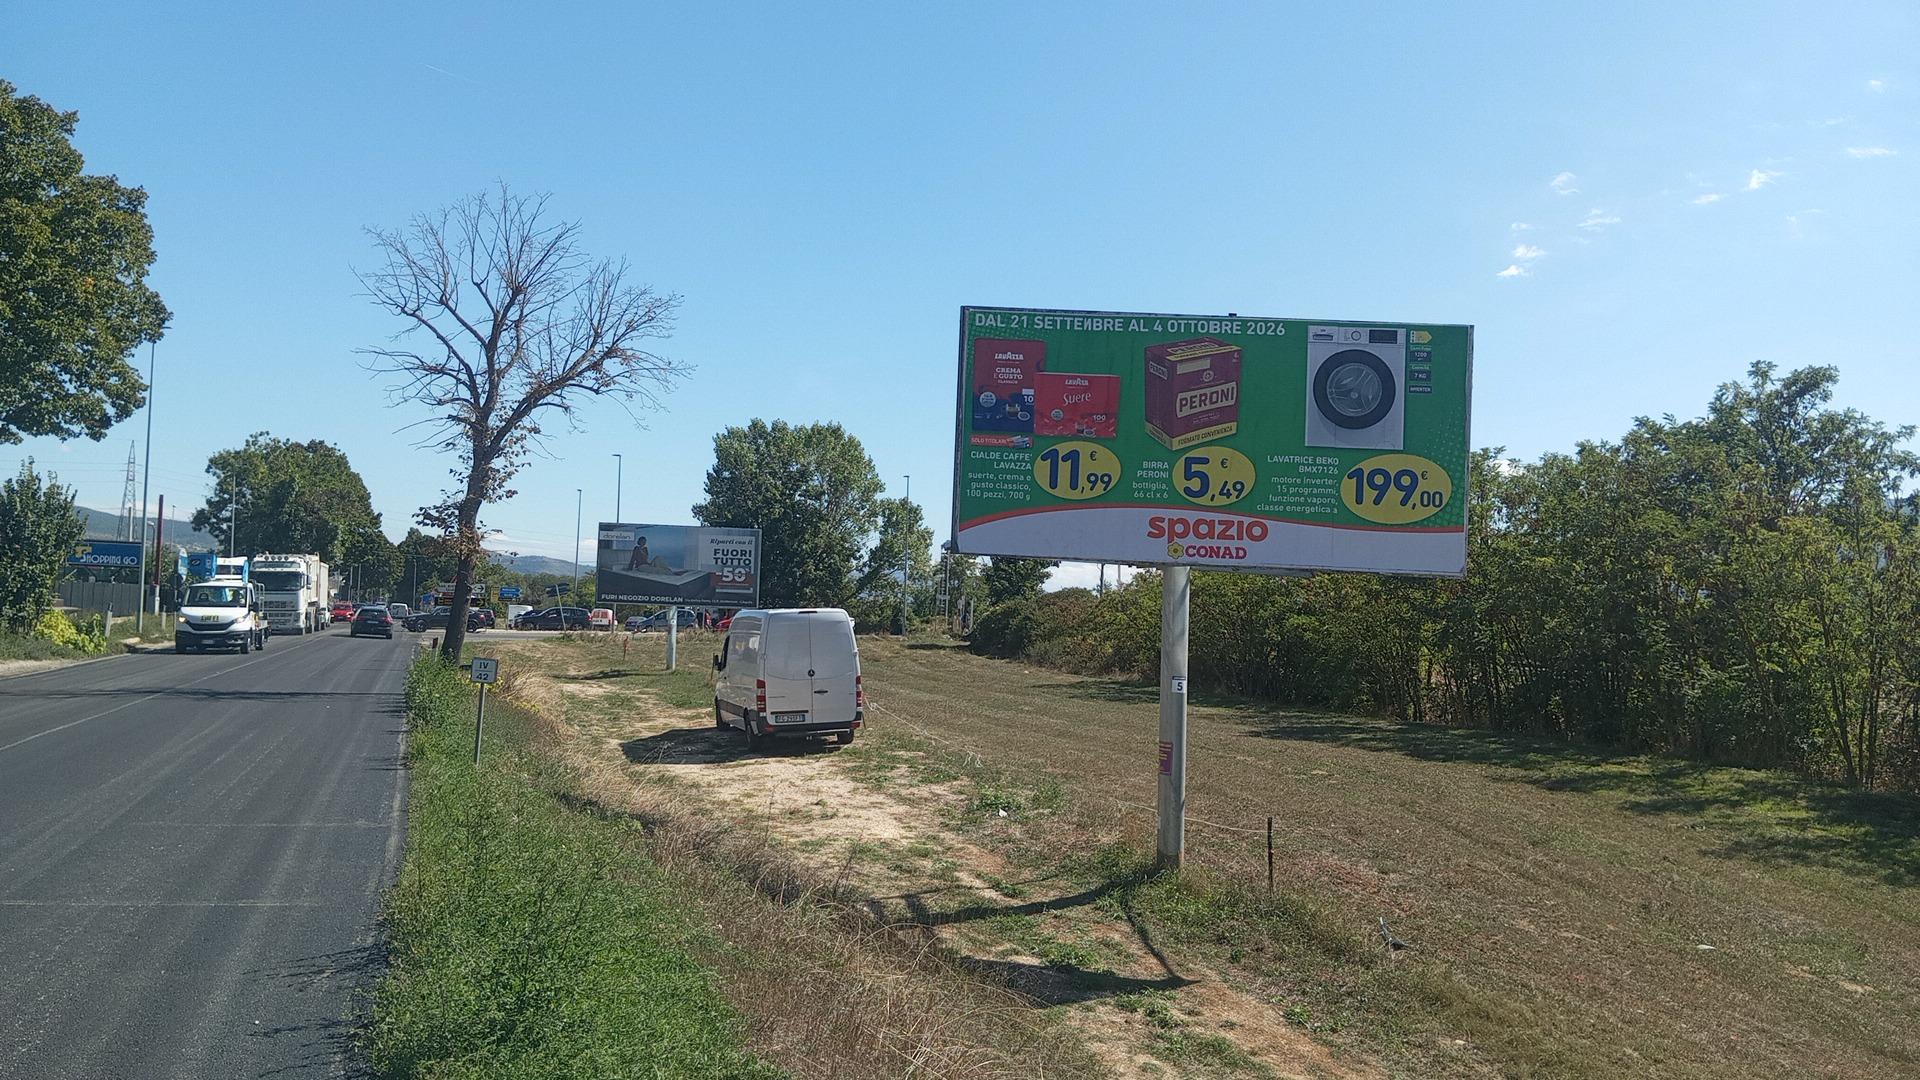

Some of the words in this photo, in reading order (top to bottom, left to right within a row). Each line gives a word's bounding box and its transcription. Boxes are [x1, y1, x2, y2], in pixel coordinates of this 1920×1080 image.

[975, 314, 1006, 328] DAL
[1010, 315, 1028, 328] 21
[1128, 320, 1149, 332] AL
[1153, 320, 1163, 332] 4
[1168, 320, 1242, 334] OTTOBRE
[1246, 322, 1286, 336] 2026
[1180, 387, 1234, 412] PERONI
[970, 450, 1000, 459] CIALDE
[1267, 456, 1314, 464] LAVATRICE
[1316, 456, 1338, 465] BEKO
[1299, 466, 1338, 474] BMX7126
[995, 481, 1031, 491] classico,
[1133, 481, 1168, 490] bottiglia,
[1269, 494, 1305, 502] funzione
[1286, 505, 1331, 514] energetica
[1147, 516, 1268, 544] spazio
[714, 549, 752, 558] FUORI
[1185, 545, 1247, 559] CONAD
[123, 556, 137, 564] GO
[713, 557, 752, 566] TUTTO
